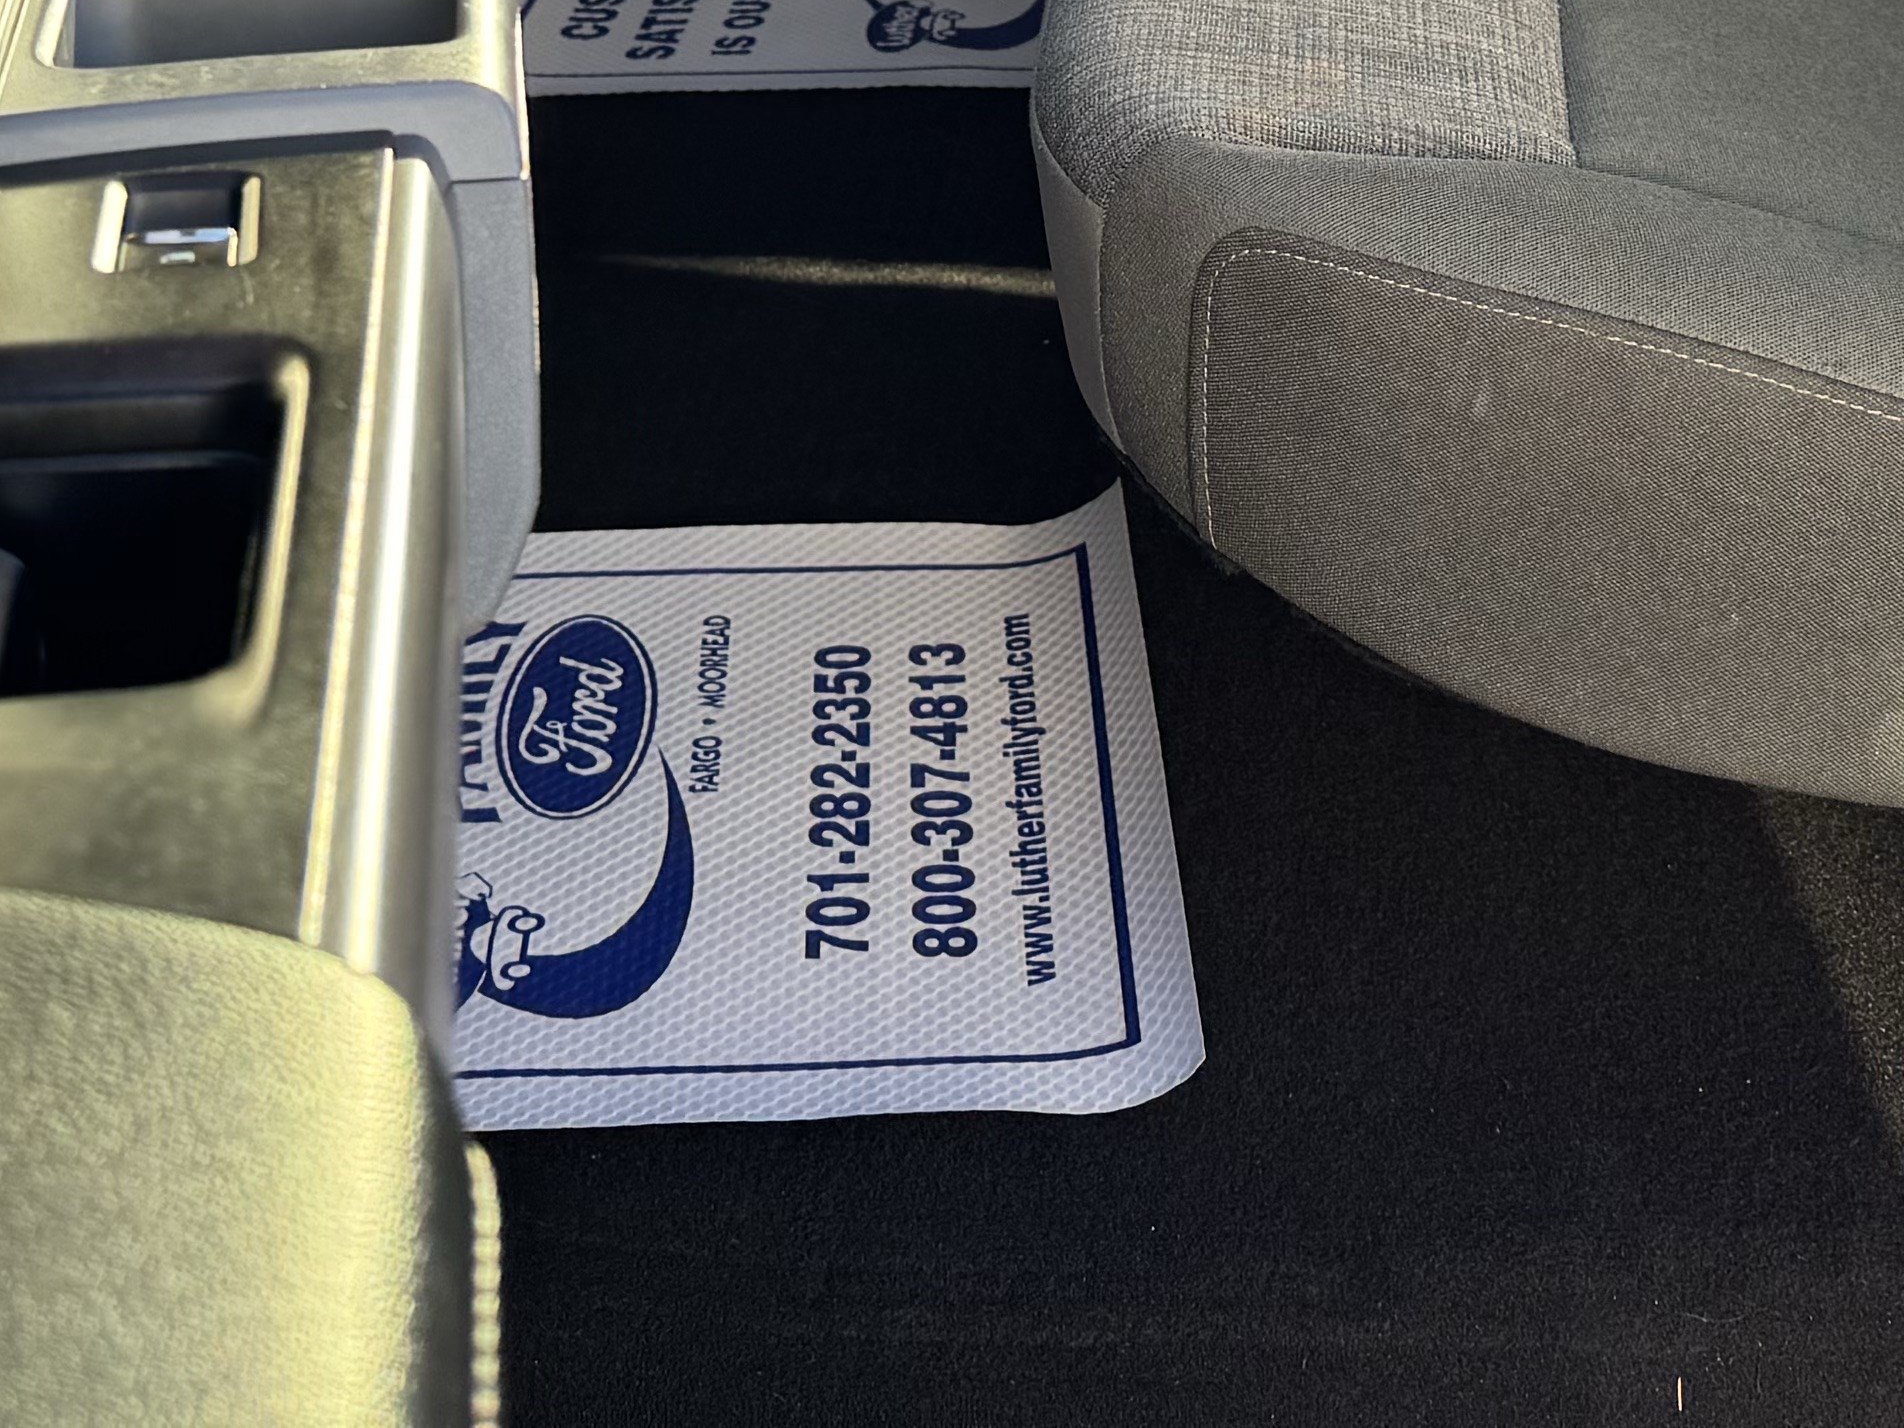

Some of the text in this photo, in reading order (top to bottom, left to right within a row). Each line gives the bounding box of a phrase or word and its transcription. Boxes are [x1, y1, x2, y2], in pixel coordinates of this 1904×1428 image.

[711, 36, 757, 56] IS
[518, 656, 625, 777] Ford
[688, 614, 732, 794] FARGO MOORHEAD
[804, 644, 872, 960] 701-282-2350
[907, 642, 979, 959] 800-307-4813
[999, 612, 1057, 988] www.lutherfamilyford.com
